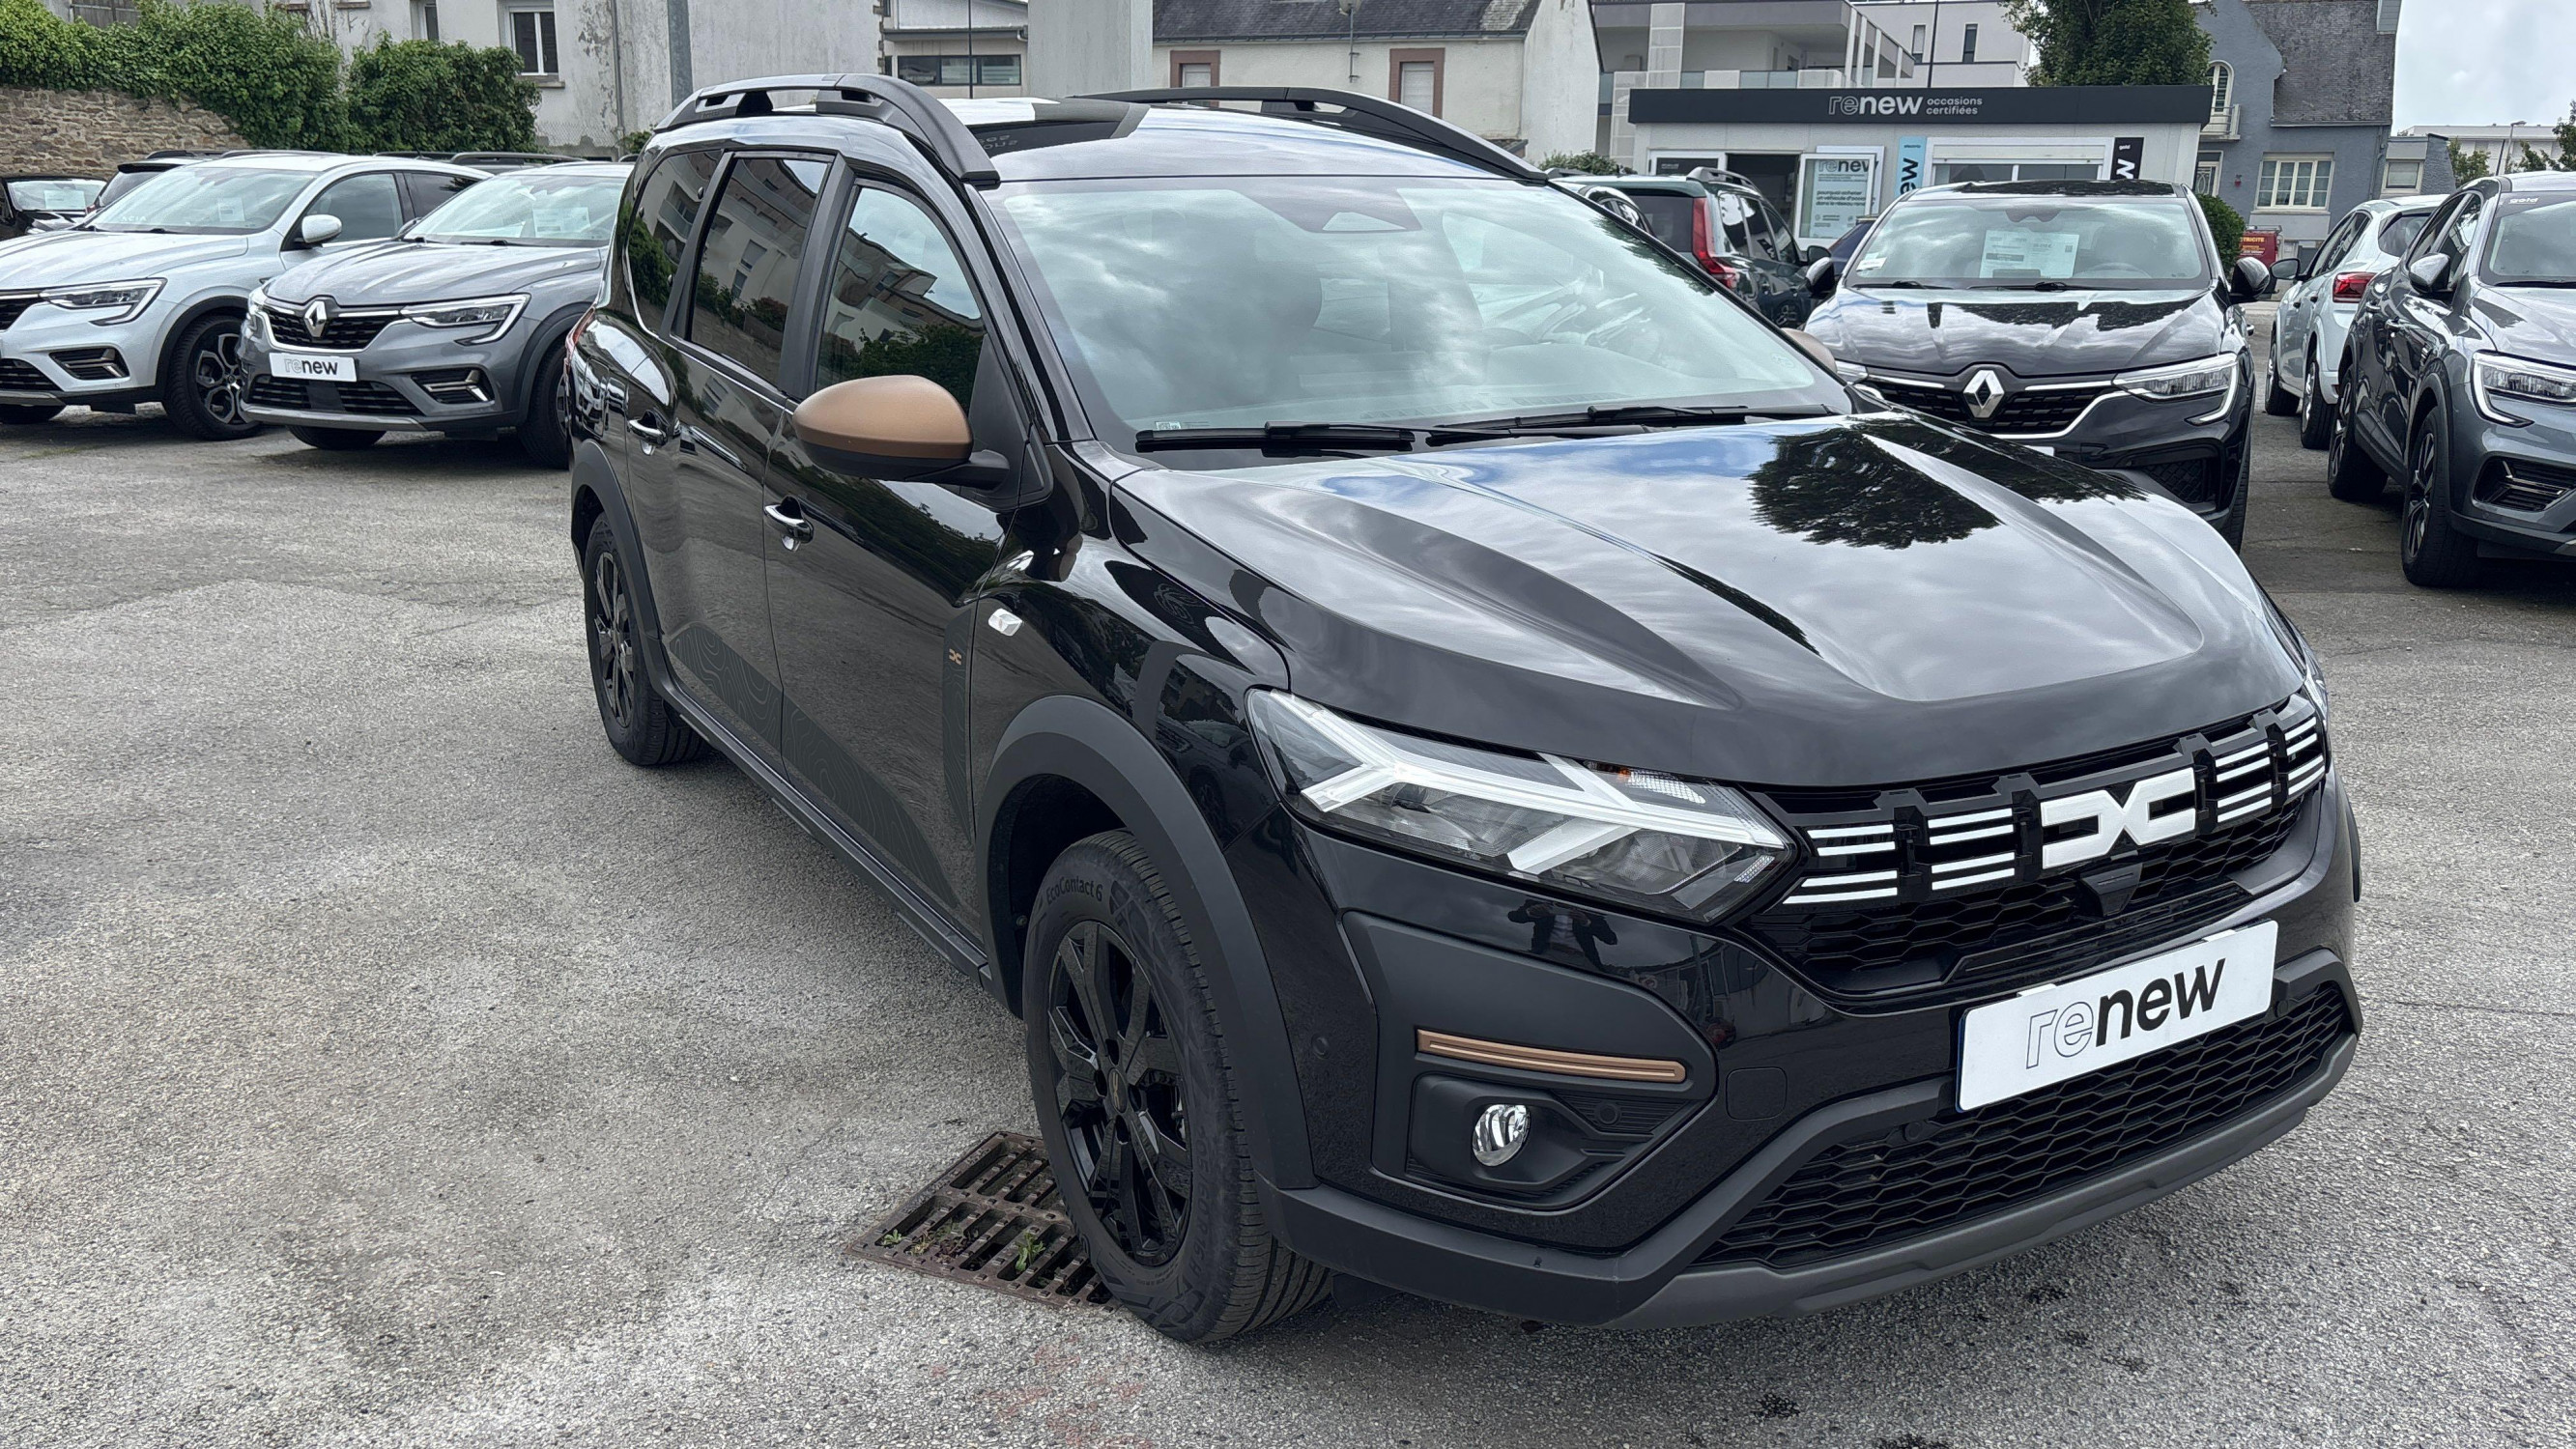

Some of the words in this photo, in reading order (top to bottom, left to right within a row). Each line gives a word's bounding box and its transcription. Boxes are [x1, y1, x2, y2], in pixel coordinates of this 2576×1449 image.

[1829, 96, 1923, 115] renew
[1926, 104, 1978, 115] certifiées
[1927, 97, 1983, 106] occasions
[284, 358, 338, 376] renew
[1045, 875, 1095, 905] EcoContact
[1095, 883, 1103, 902] 6
[2025, 957, 2226, 1070] renew
